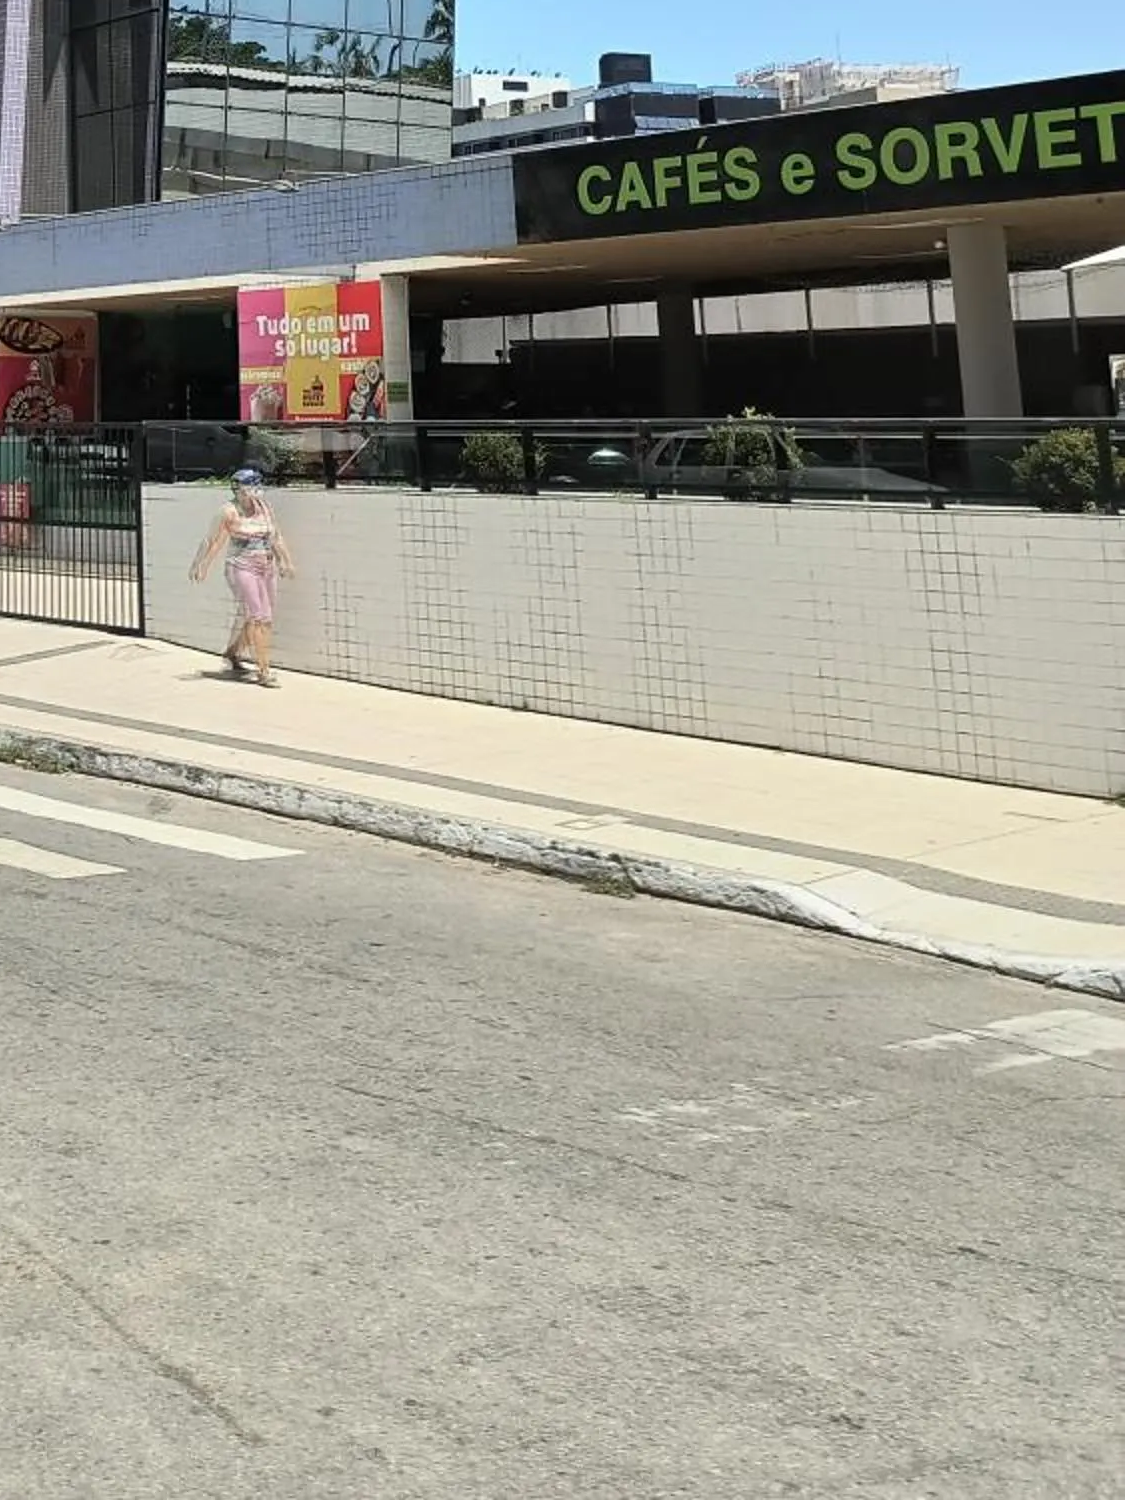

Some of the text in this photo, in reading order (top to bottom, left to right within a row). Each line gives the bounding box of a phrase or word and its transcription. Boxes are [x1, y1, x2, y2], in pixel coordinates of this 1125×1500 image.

[576, 100, 1125, 216] CAFÉS e SORVET
[256, 312, 370, 336] Tudo em um
[300, 332, 357, 361] lugar!
